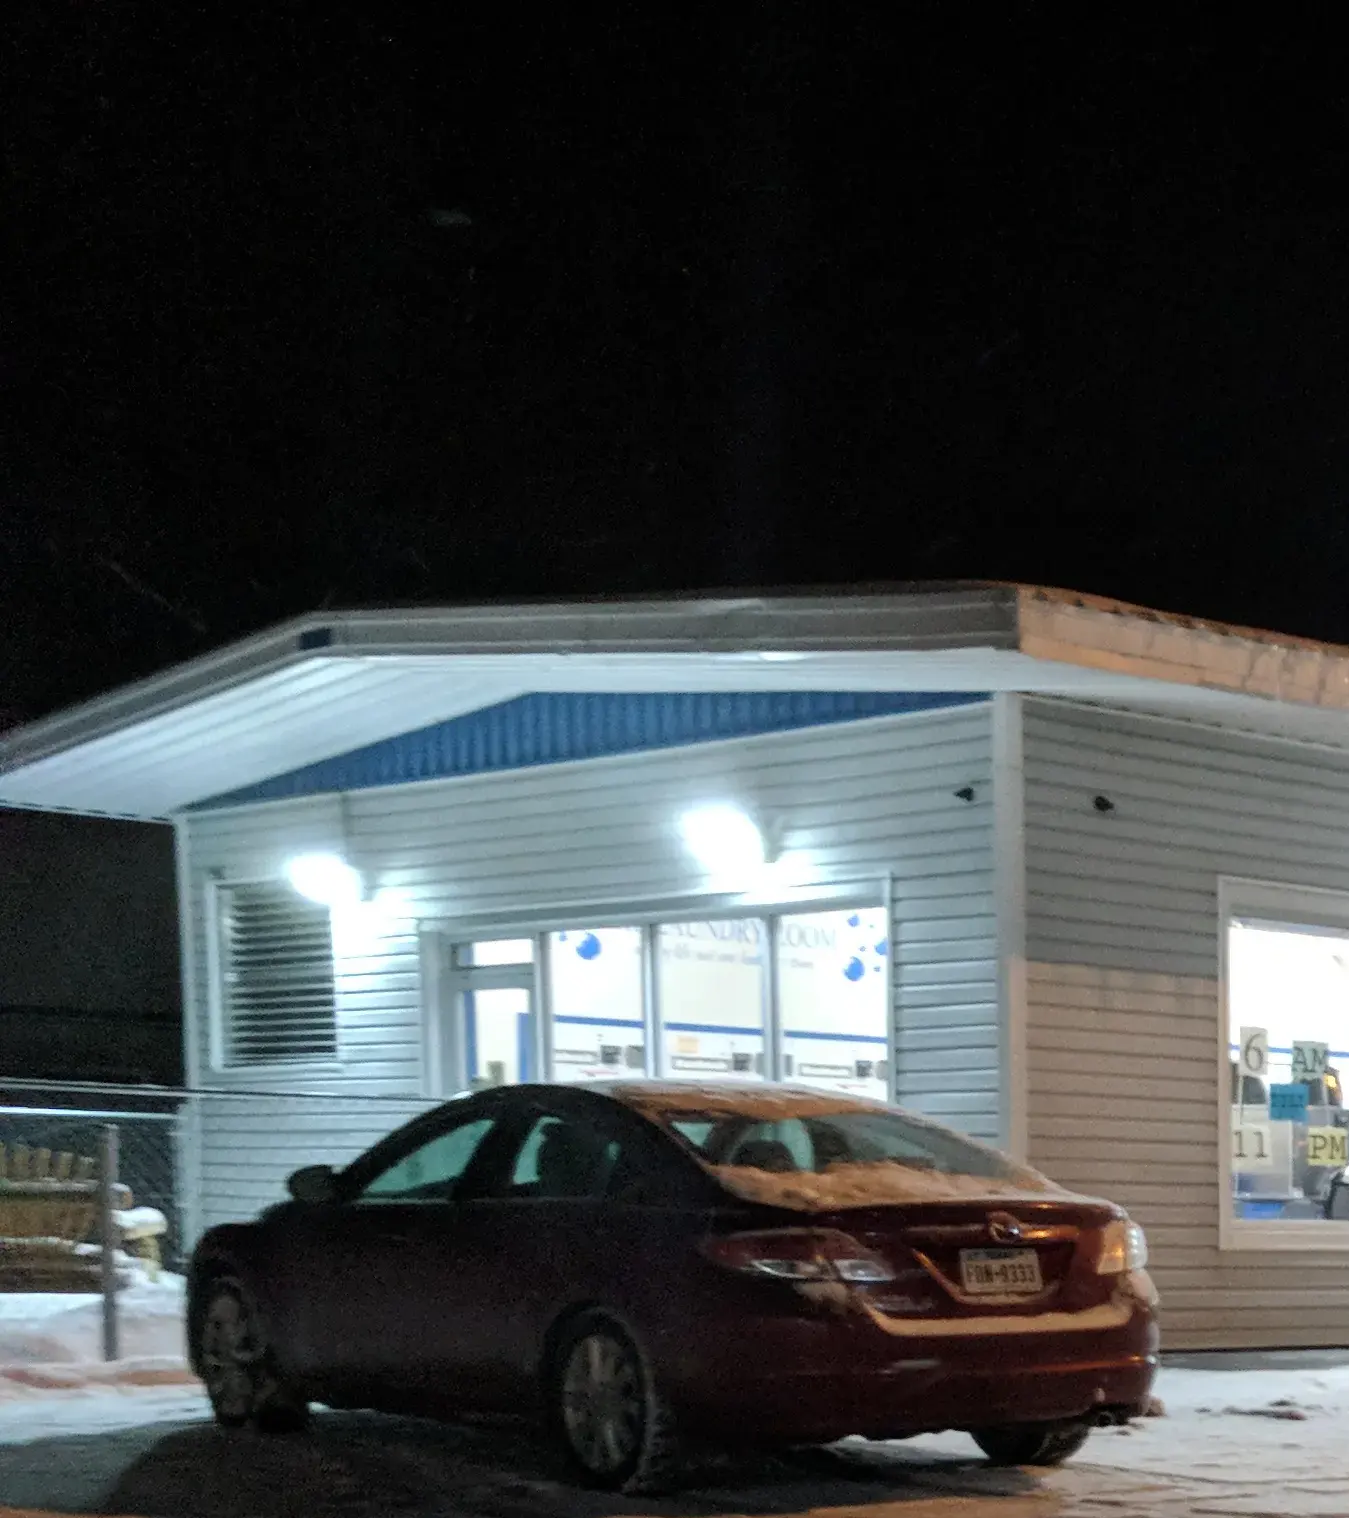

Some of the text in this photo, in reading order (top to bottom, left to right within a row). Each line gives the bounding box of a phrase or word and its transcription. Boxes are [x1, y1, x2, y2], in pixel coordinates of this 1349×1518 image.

[1244, 1032, 1329, 1073] 6 AM
[1234, 1130, 1347, 1160] 11 PM
